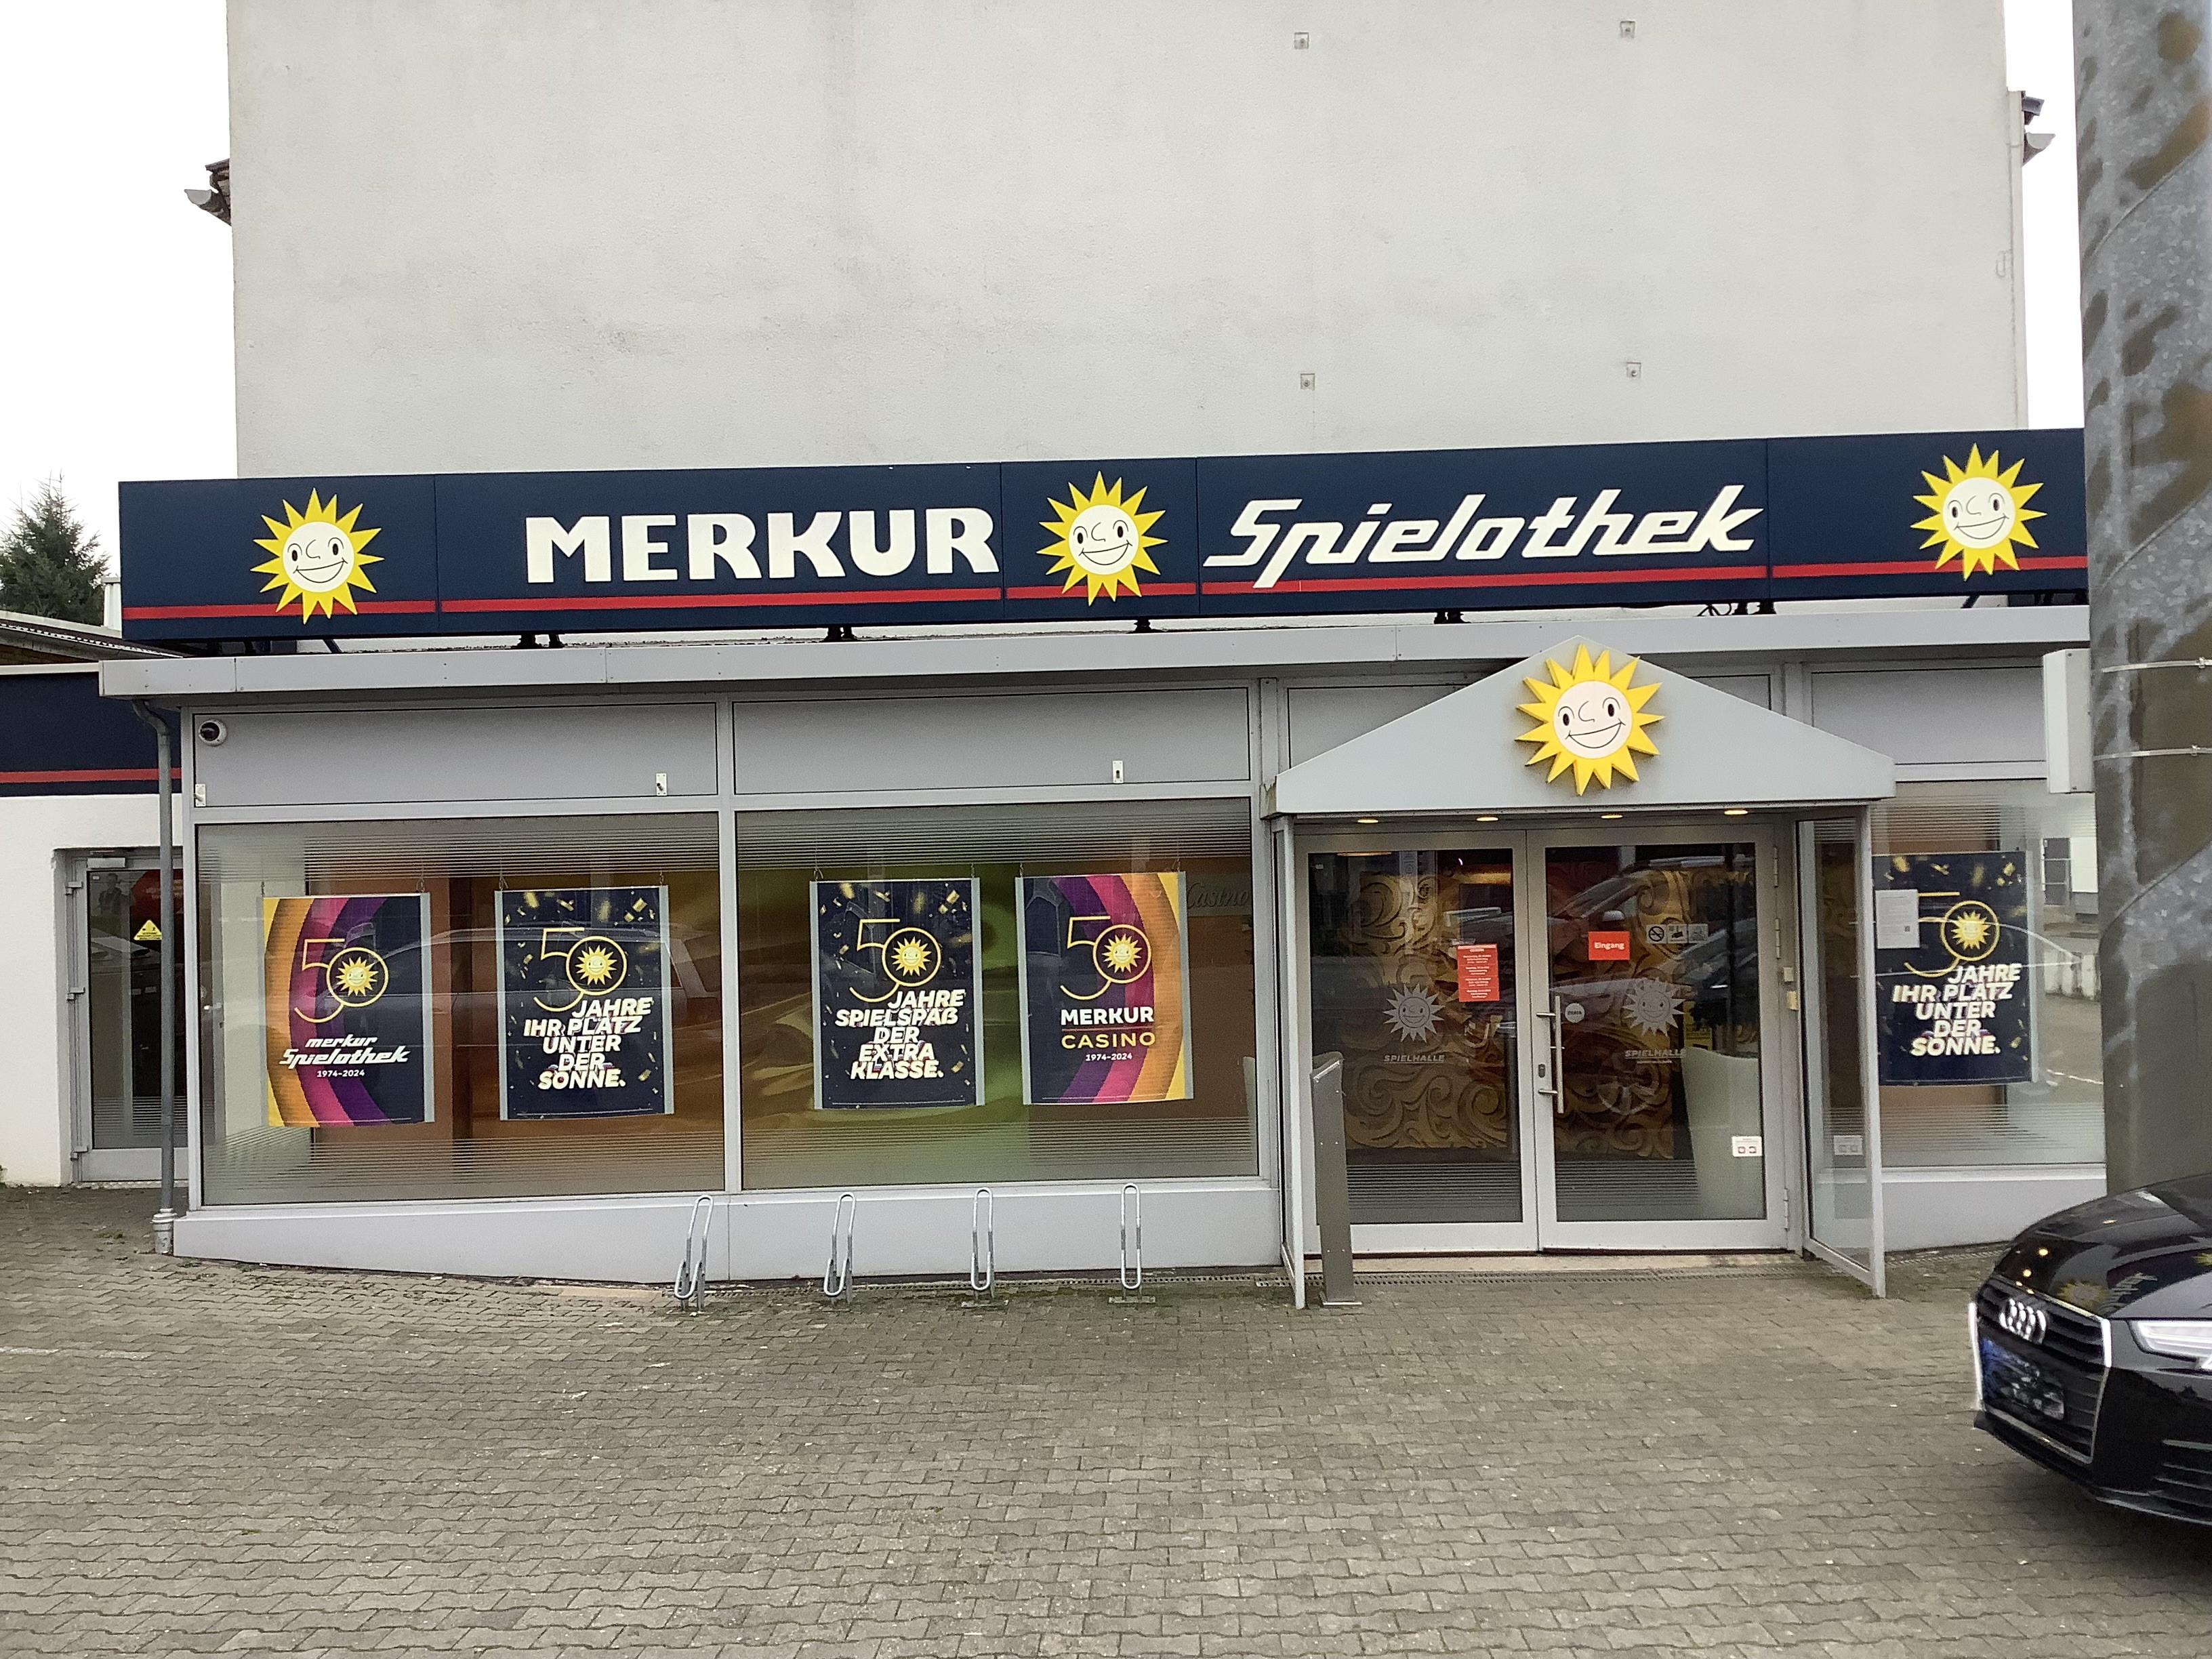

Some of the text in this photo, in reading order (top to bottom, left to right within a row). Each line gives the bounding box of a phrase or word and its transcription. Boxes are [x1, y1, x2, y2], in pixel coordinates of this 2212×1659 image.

[525, 485, 1763, 588] MERKUR Spielothek
[1187, 882, 1249, 909] Casino
[1594, 942, 1624, 950] Eingang
[1948, 963, 2022, 983] JAHRE
[888, 989, 966, 1009] JAHRE
[1892, 982, 2014, 1002] IHR PLATZ
[571, 997, 654, 1018] JAHRE
[1061, 1006, 1154, 1025] MERKUR
[1916, 1001, 1996, 1020] UNTER
[523, 1016, 643, 1037] IHR PLATZ
[874, 1026, 920, 1044] DER
[1934, 1019, 1982, 1038] DER
[305, 1034, 377, 1048] merkur
[543, 1035, 621, 1054] UNTER
[1061, 1031, 1155, 1049] CASINO
[1910, 1036, 2001, 1057] SONNE.
[279, 1046, 411, 1069] Spielothek
[558, 1052, 605, 1071] DER
[859, 1043, 935, 1061] EXTRA
[1086, 1052, 1132, 1061] 1974-2024
[316, 1069, 365, 1078] 1974-2024
[538, 1069, 626, 1090] SONNE.
[850, 1060, 944, 1080] KLASSE.
